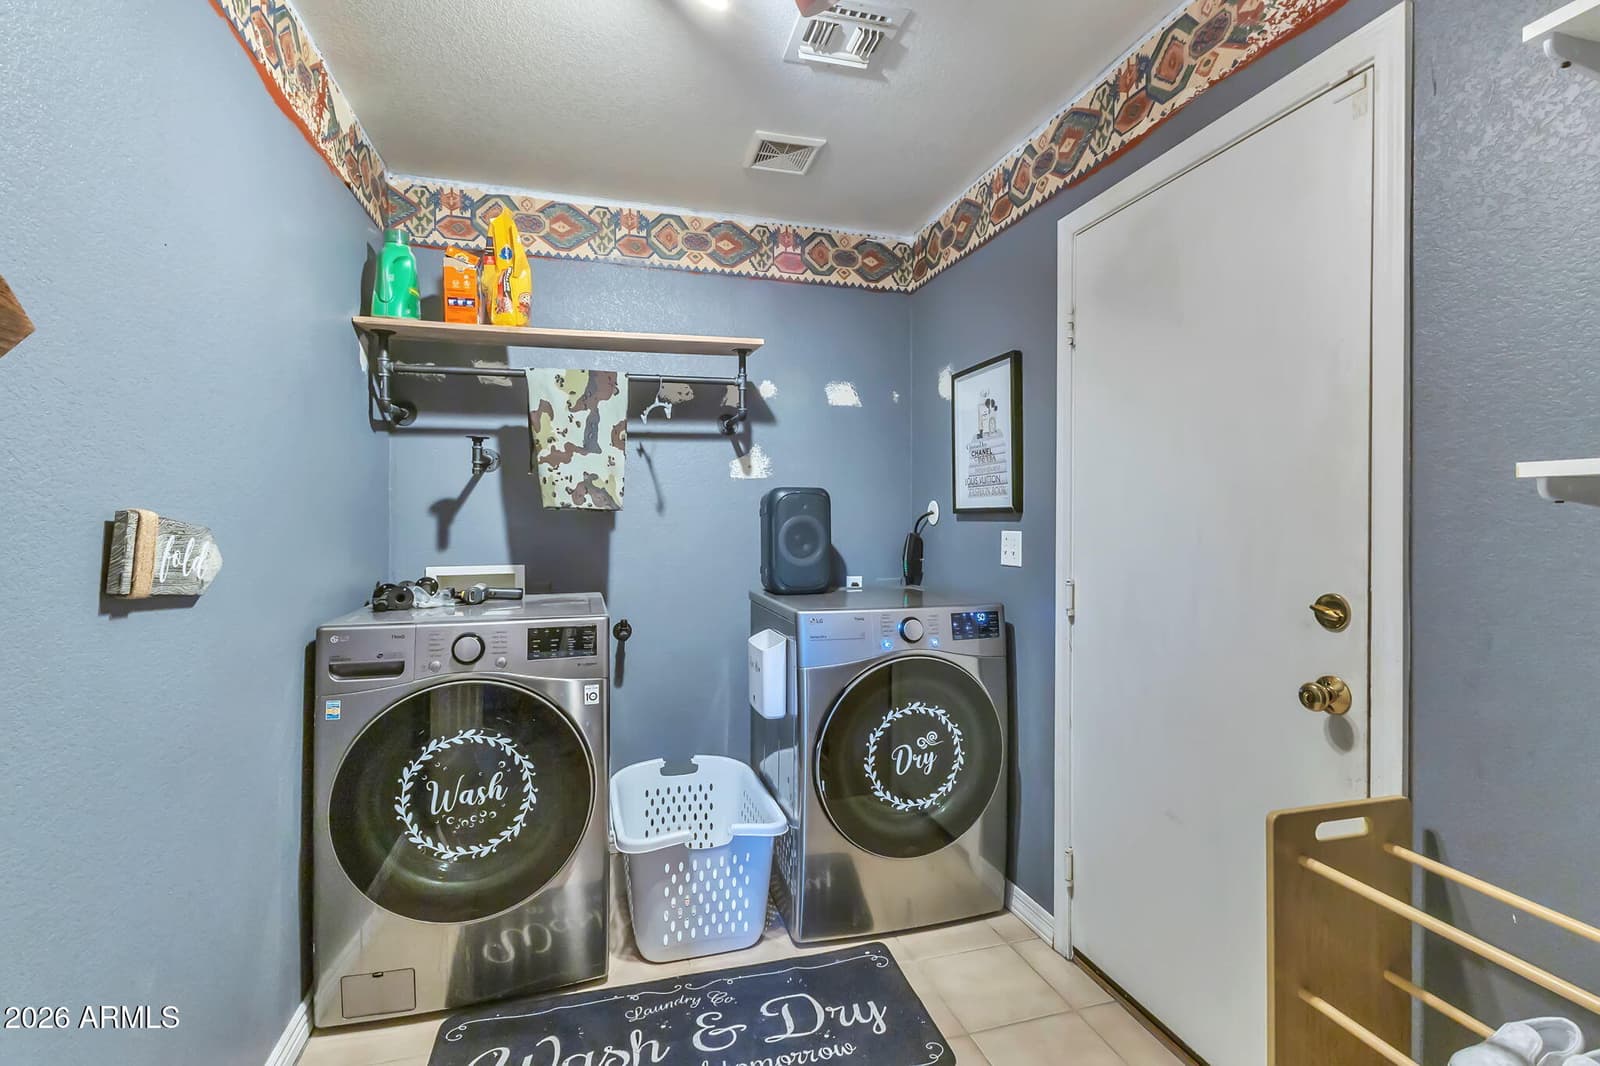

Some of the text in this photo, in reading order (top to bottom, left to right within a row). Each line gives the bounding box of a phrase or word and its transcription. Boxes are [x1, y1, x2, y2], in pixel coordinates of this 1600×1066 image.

[971, 447, 993, 457] CHANEL
[159, 535, 210, 583] fold
[891, 744, 938, 776] Dry
[425, 771, 508, 816] Wash
[625, 990, 738, 1022] Laundry Co.
[692, 1011, 748, 1052] &
[760, 993, 887, 1044] Dry
[721, 1041, 857, 1066] morrow
